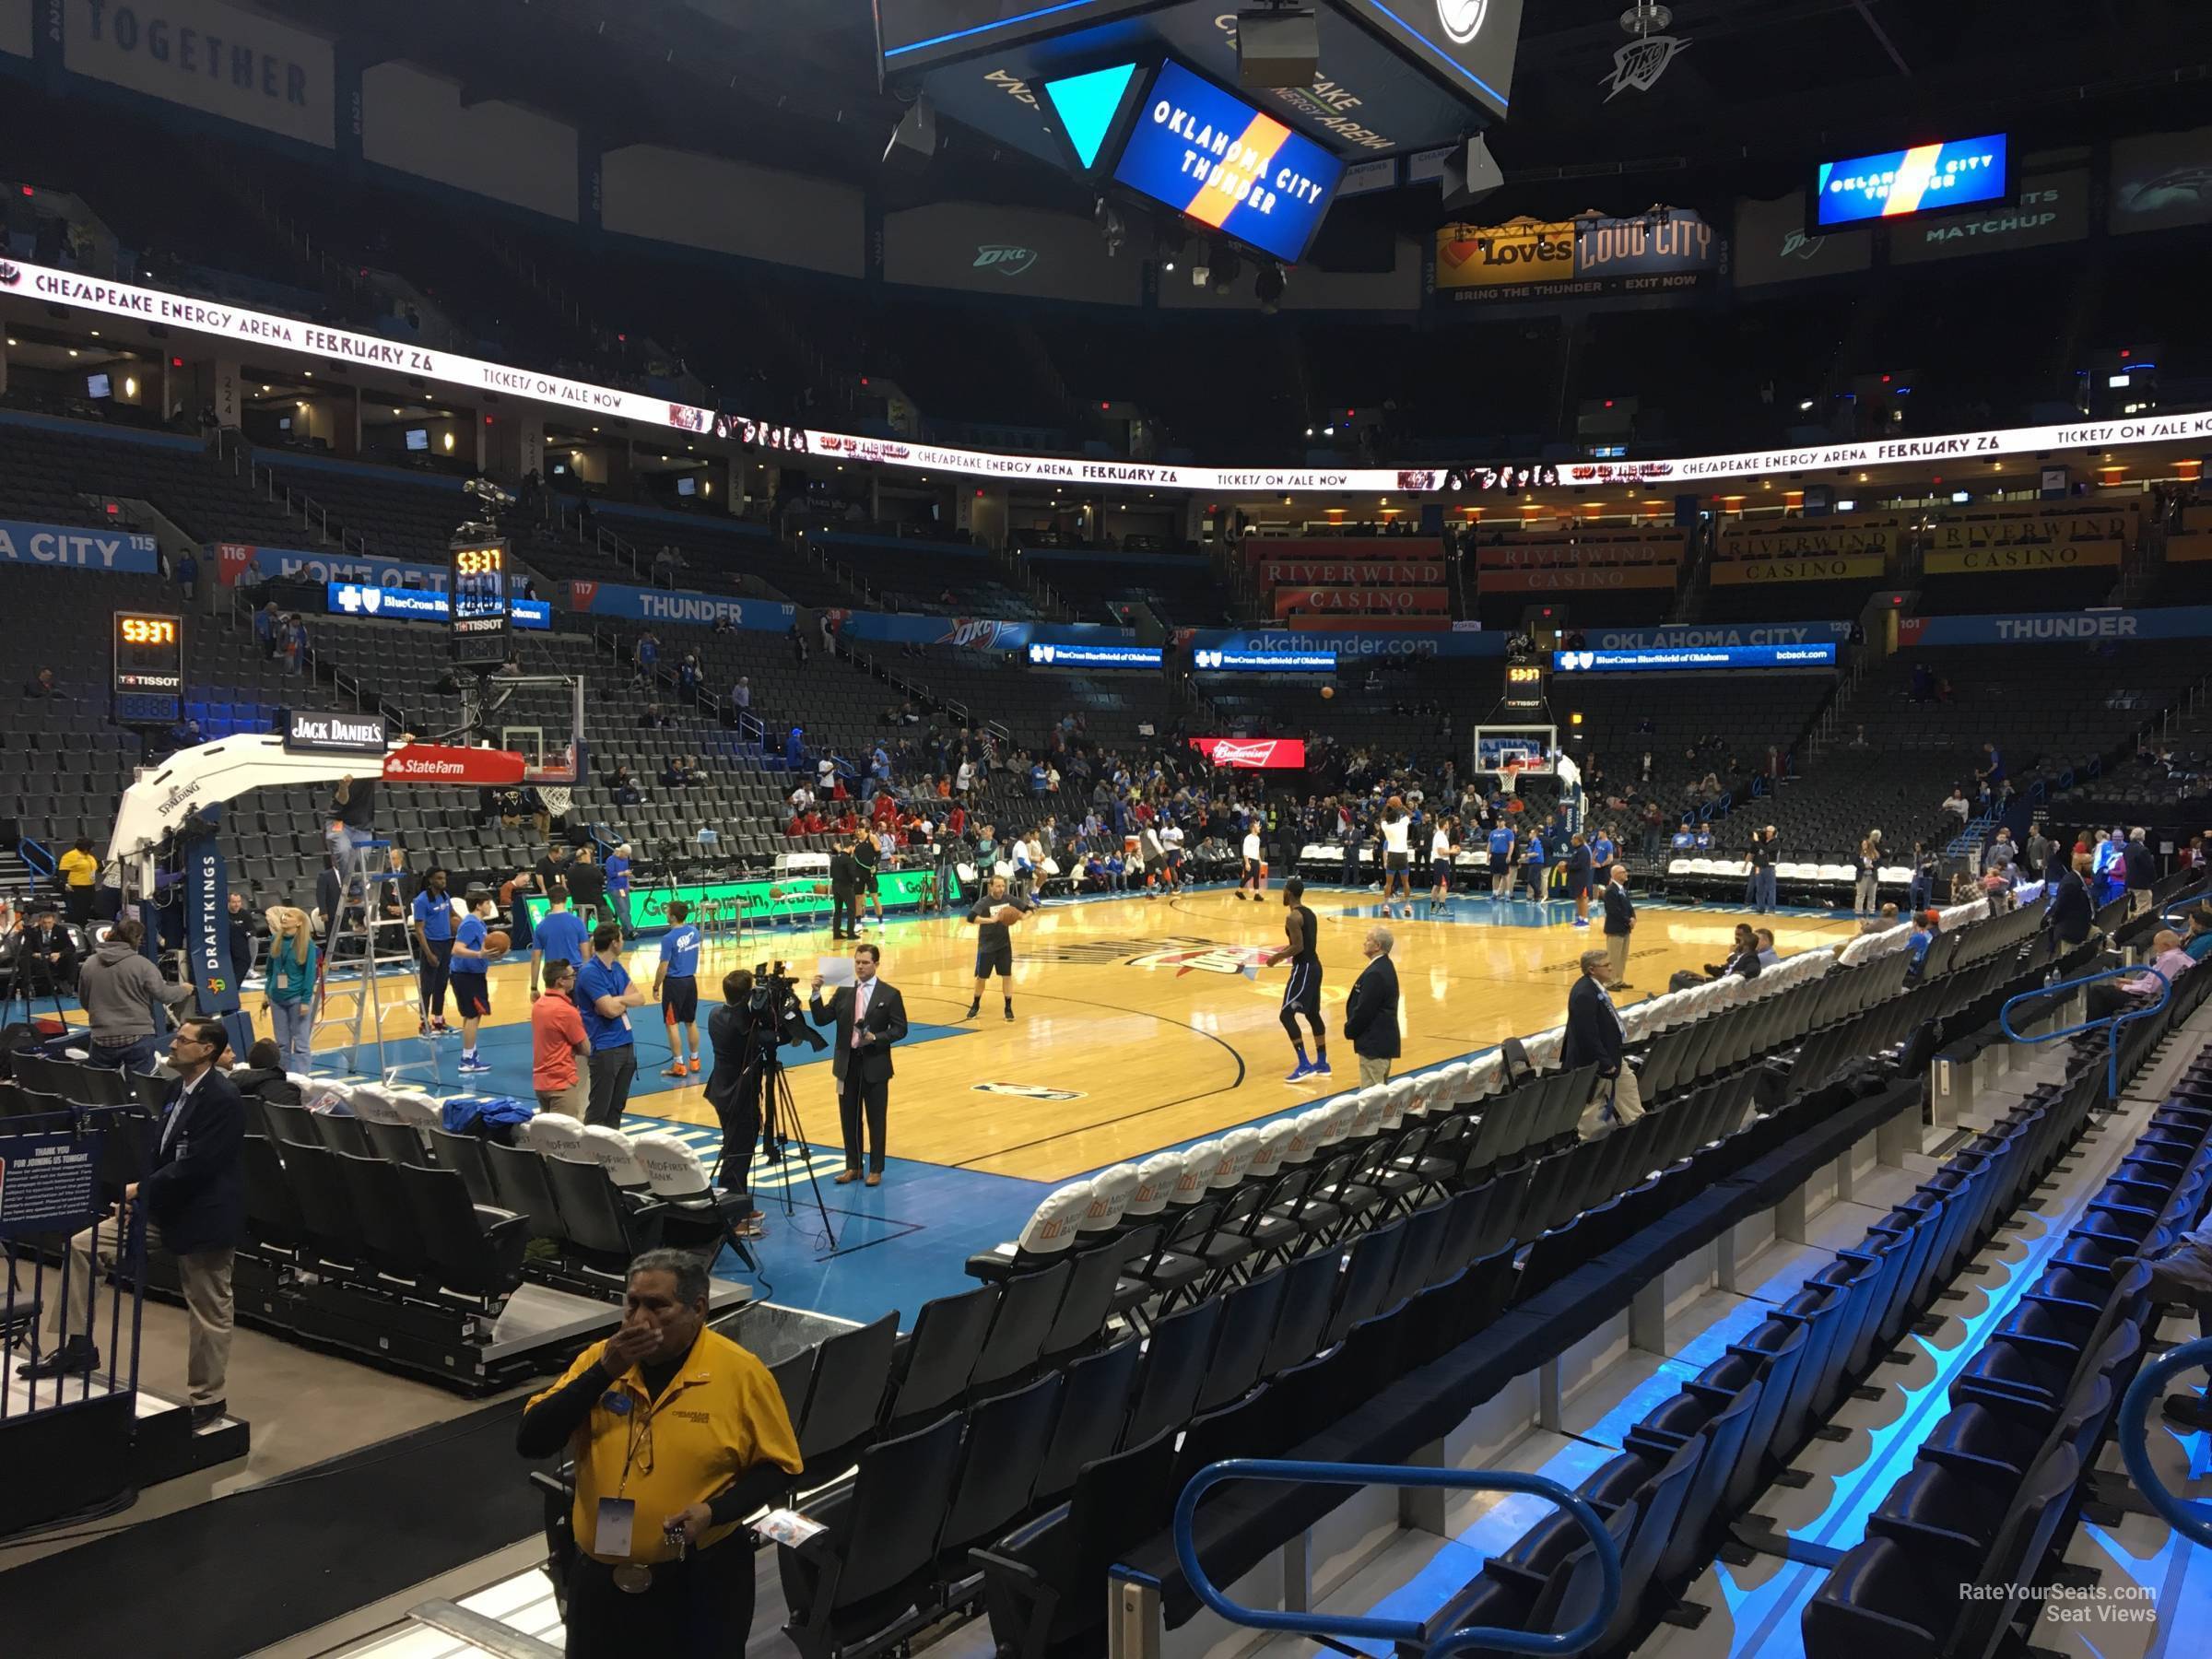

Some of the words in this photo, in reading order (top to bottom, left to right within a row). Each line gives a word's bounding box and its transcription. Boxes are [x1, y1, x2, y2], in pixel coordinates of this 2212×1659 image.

[90, 0, 307, 107] TOGETHER
[1270, 87, 1325, 117] NERGY
[1315, 116, 1396, 150] ARENA
[1153, 100, 1270, 179] OKLAHOMA
[1277, 167, 1324, 205] CITY
[1946, 154, 1994, 173] CITY
[1181, 149, 1277, 215] THUNDER
[1925, 212, 2057, 241] MATCHUP
[1581, 221, 1646, 271] LOUD
[1655, 219, 1712, 260] CITY
[1454, 289, 1500, 301] BRING
[1502, 287, 1531, 298] THE
[1534, 281, 1603, 296] THUNDER
[1625, 276, 1660, 289] EXIT
[1662, 275, 1697, 287] NOW
[35, 275, 153, 313] CHESAPEAKE
[160, 300, 233, 328] ENERGY
[240, 320, 293, 342] ARENA
[306, 330, 405, 366] FEBRUARY
[483, 369, 532, 390] TICKETS
[536, 381, 557, 395] ON
[559, 383, 589, 403] SALE
[593, 394, 622, 409] NOW
[2057, 428, 2113, 444] TICKETS
[2120, 423, 2146, 440] ON
[2150, 420, 2188, 436] SALE
[917, 451, 982, 469] CHESAPEAKE
[986, 460, 1032, 473] ENERGY
[1036, 465, 1074, 477] ARENA
[1082, 465, 1156, 482] FEBRUARY
[1682, 456, 1760, 476] CHESAPEAKE
[1765, 452, 1818, 468] ENERGY
[1824, 449, 1867, 463] ARENA
[1878, 439, 1971, 459] FEBRUARY
[1218, 475, 1261, 485] TICKETS
[1265, 475, 1283, 486] ON
[1288, 475, 1315, 486] SALE
[1319, 475, 1347, 486] NOW
[1946, 518, 2126, 543] RIVERWIND
[29, 533, 121, 567] CITY
[129, 535, 156, 551] 115
[1729, 532, 1887, 554] RIVERWIND
[221, 546, 247, 561] 116
[1504, 546, 1656, 564] RIVERWIND
[1963, 547, 2078, 569] CASINO
[1267, 565, 1439, 582] RIVERWIND
[1527, 571, 1625, 588] CASINO
[1746, 560, 1848, 580] CASINO
[574, 582, 593, 595] 117
[384, 595, 434, 611] BlueCross
[639, 594, 743, 624] THUNDER
[781, 604, 795, 616] 117
[1309, 592, 1414, 608] CASINO
[468, 618, 503, 631] TISSOT
[830, 610, 841, 620] 18
[1900, 618, 1921, 629] 101
[122, 618, 174, 643] 53:37
[1120, 627, 1135, 638] 118
[1995, 615, 2137, 640] THUNDER
[1248, 634, 1438, 655] okcthunder.com
[1601, 629, 1747, 651] OKLAHOMA
[1749, 627, 1809, 646] CITY
[1595, 655, 1637, 665] BlueCross
[1637, 654, 1680, 665] BlueShield
[1680, 654, 1688, 664] of
[1689, 653, 1729, 663] Oklahoma
[1776, 650, 1828, 661] bcbsok.com
[136, 676, 180, 688] TISSOT
[291, 717, 328, 739] JACK
[1213, 747, 1270, 759] Budweiser
[158, 782, 201, 818] SPALDING
[203, 855, 219, 970] DRAFTKINGS
[13, 1159, 27, 1169] FOR
[27, 1157, 53, 1167] JOINING
[53, 1155, 62, 1164] US
[63, 1152, 88, 1164] TONIGHT
[35, 1147, 55, 1157] THANK
[56, 1145, 70, 1155] YOU
[647, 1159, 688, 1173] MIDFIRST
[649, 1171, 674, 1182] BANK
